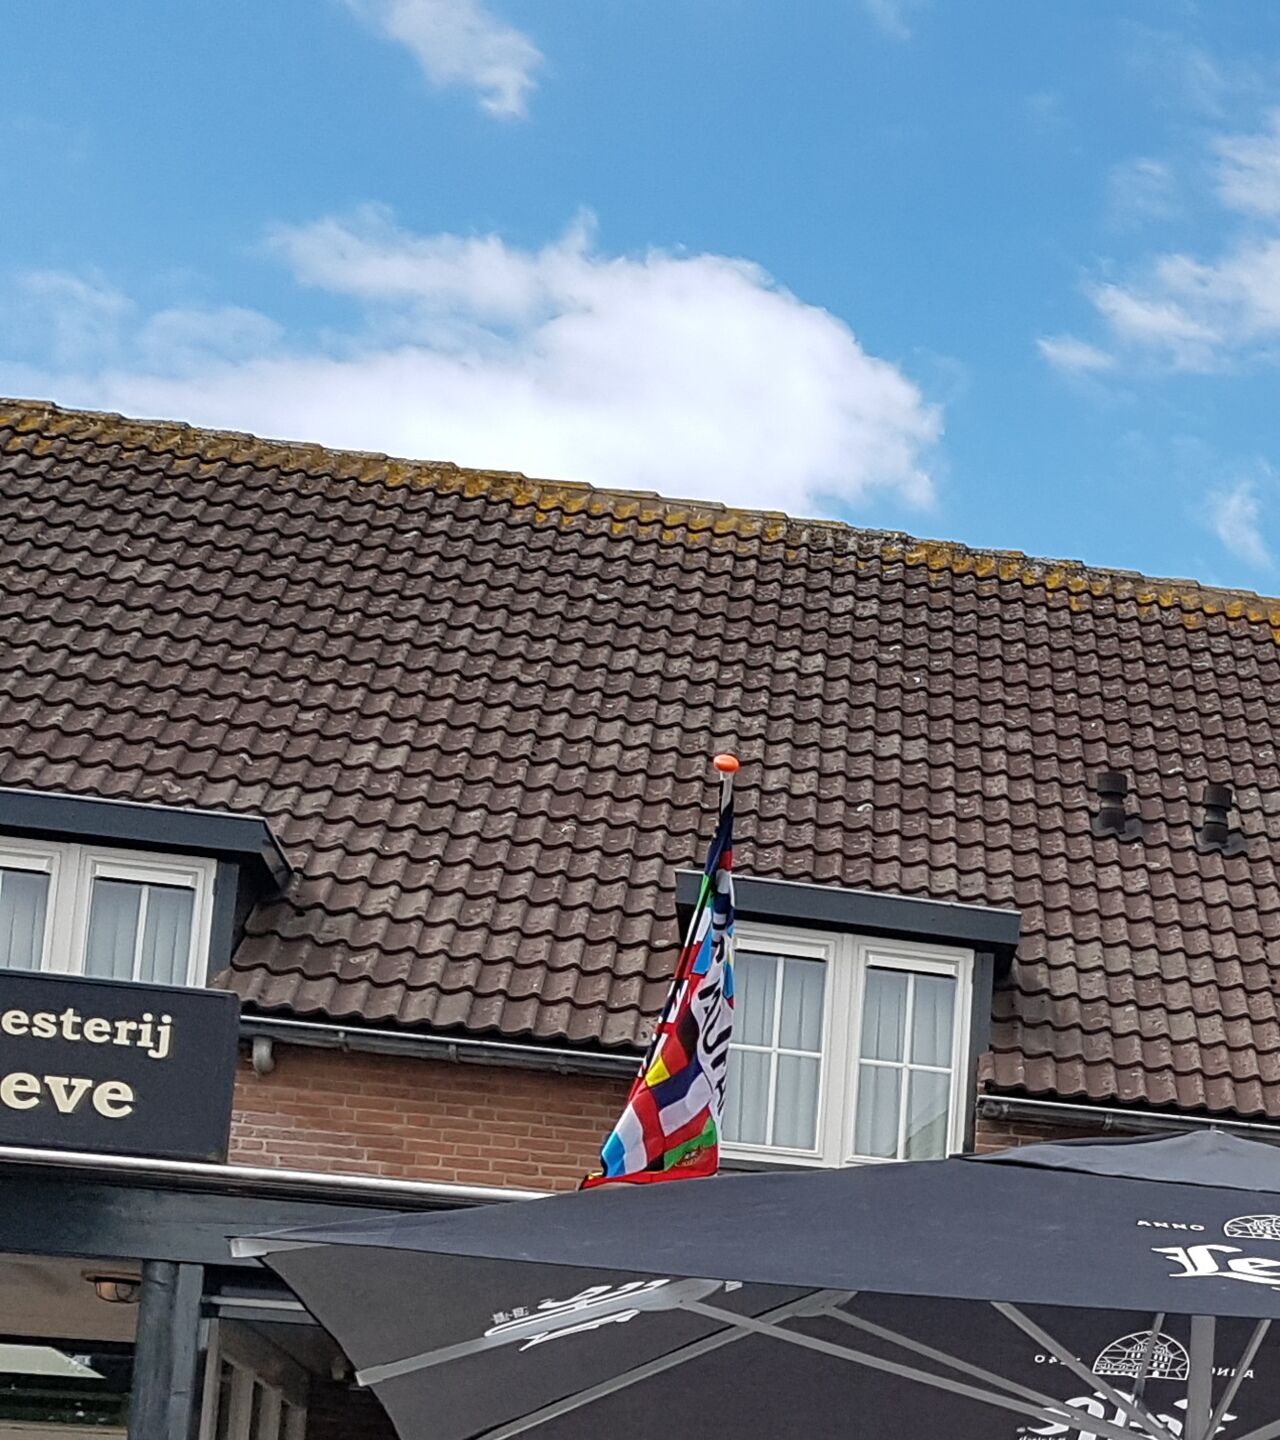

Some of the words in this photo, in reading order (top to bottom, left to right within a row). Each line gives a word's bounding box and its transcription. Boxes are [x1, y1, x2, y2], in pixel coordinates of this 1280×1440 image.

[0, 1007, 173, 1059] esterij
[0, 1071, 135, 1119] eve
[1137, 1219, 1205, 1231] ANNO
